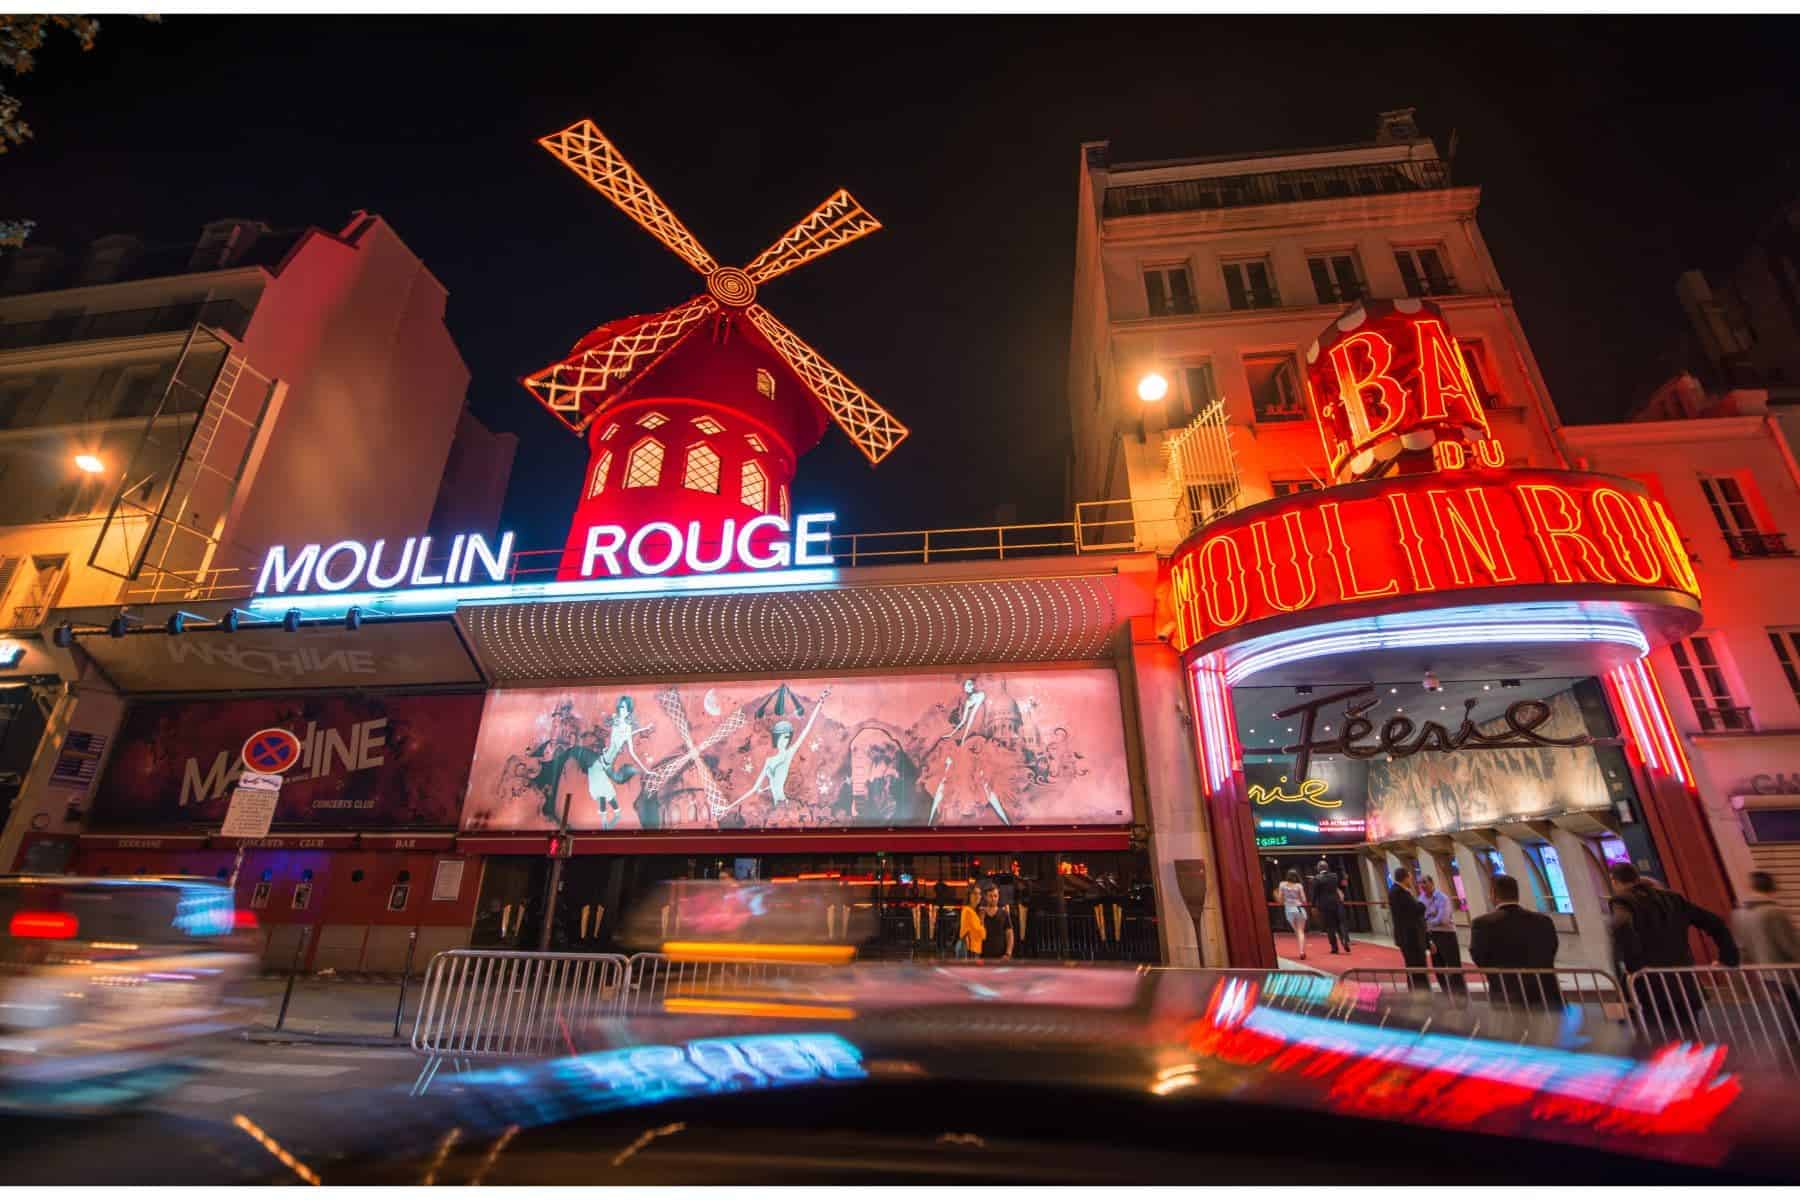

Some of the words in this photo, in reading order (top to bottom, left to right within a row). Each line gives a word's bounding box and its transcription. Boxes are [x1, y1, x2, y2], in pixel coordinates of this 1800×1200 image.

[1436, 440, 1505, 470] DU
[255, 531, 515, 593] MOULIN
[580, 512, 836, 577] ROUGE
[1171, 487, 1516, 652] MOULIN
